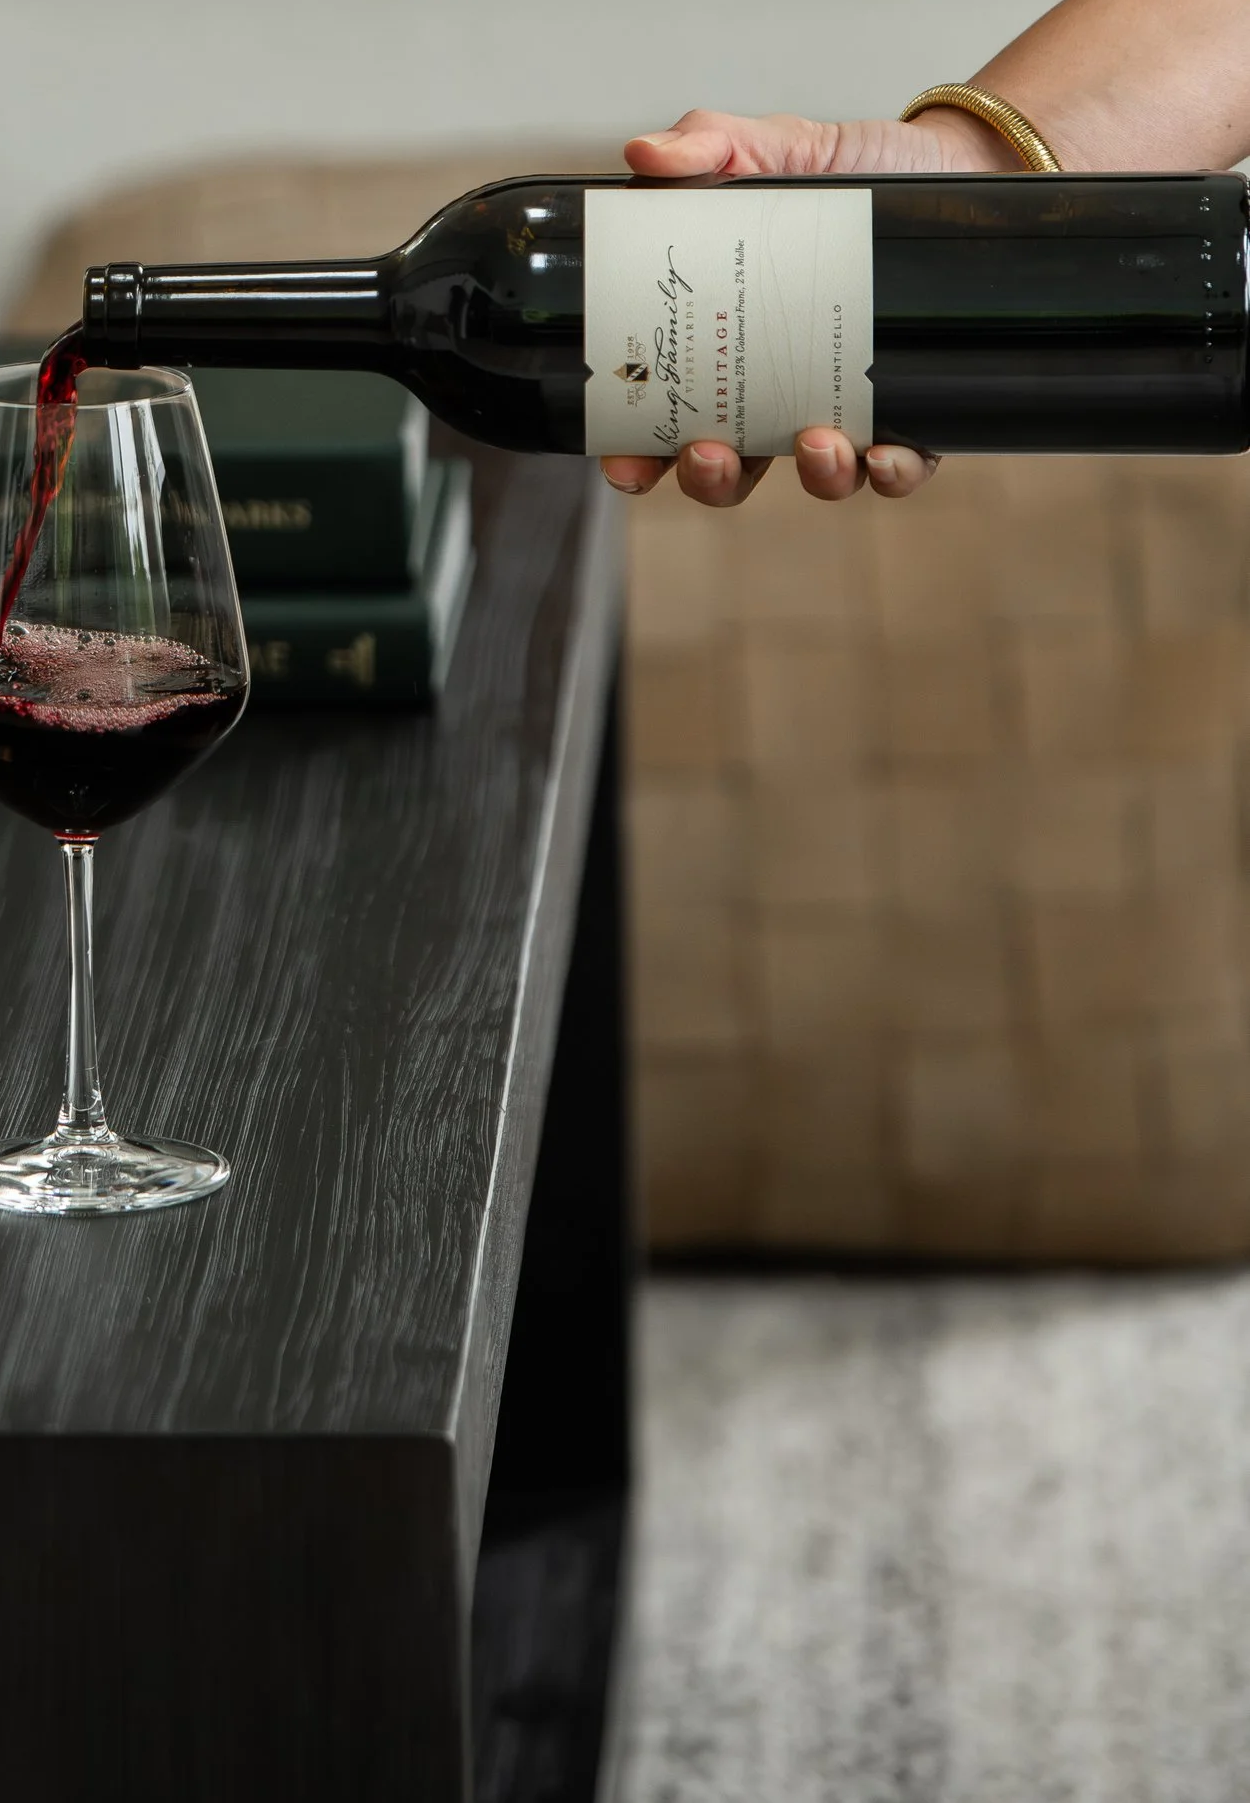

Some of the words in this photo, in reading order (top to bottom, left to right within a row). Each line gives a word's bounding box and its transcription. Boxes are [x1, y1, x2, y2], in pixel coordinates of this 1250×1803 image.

[734, 239, 746, 267] Malbec
[734, 269, 746, 284] 2%
[734, 287, 748, 313] Franc,
[654, 245, 694, 385] Family
[626, 335, 635, 359] 1998
[685, 300, 695, 394] VINEYARDS
[734, 315, 746, 353] Cabernet
[833, 304, 842, 392] MONTICELLO
[716, 310, 728, 424] MERITAGE
[734, 355, 746, 377] 23%
[626, 386, 635, 406] EST.
[734, 379, 748, 404] Verdot,
[652, 385, 699, 454] King
[734, 405, 746, 420] Petit
[833, 405, 842, 430] 2022
